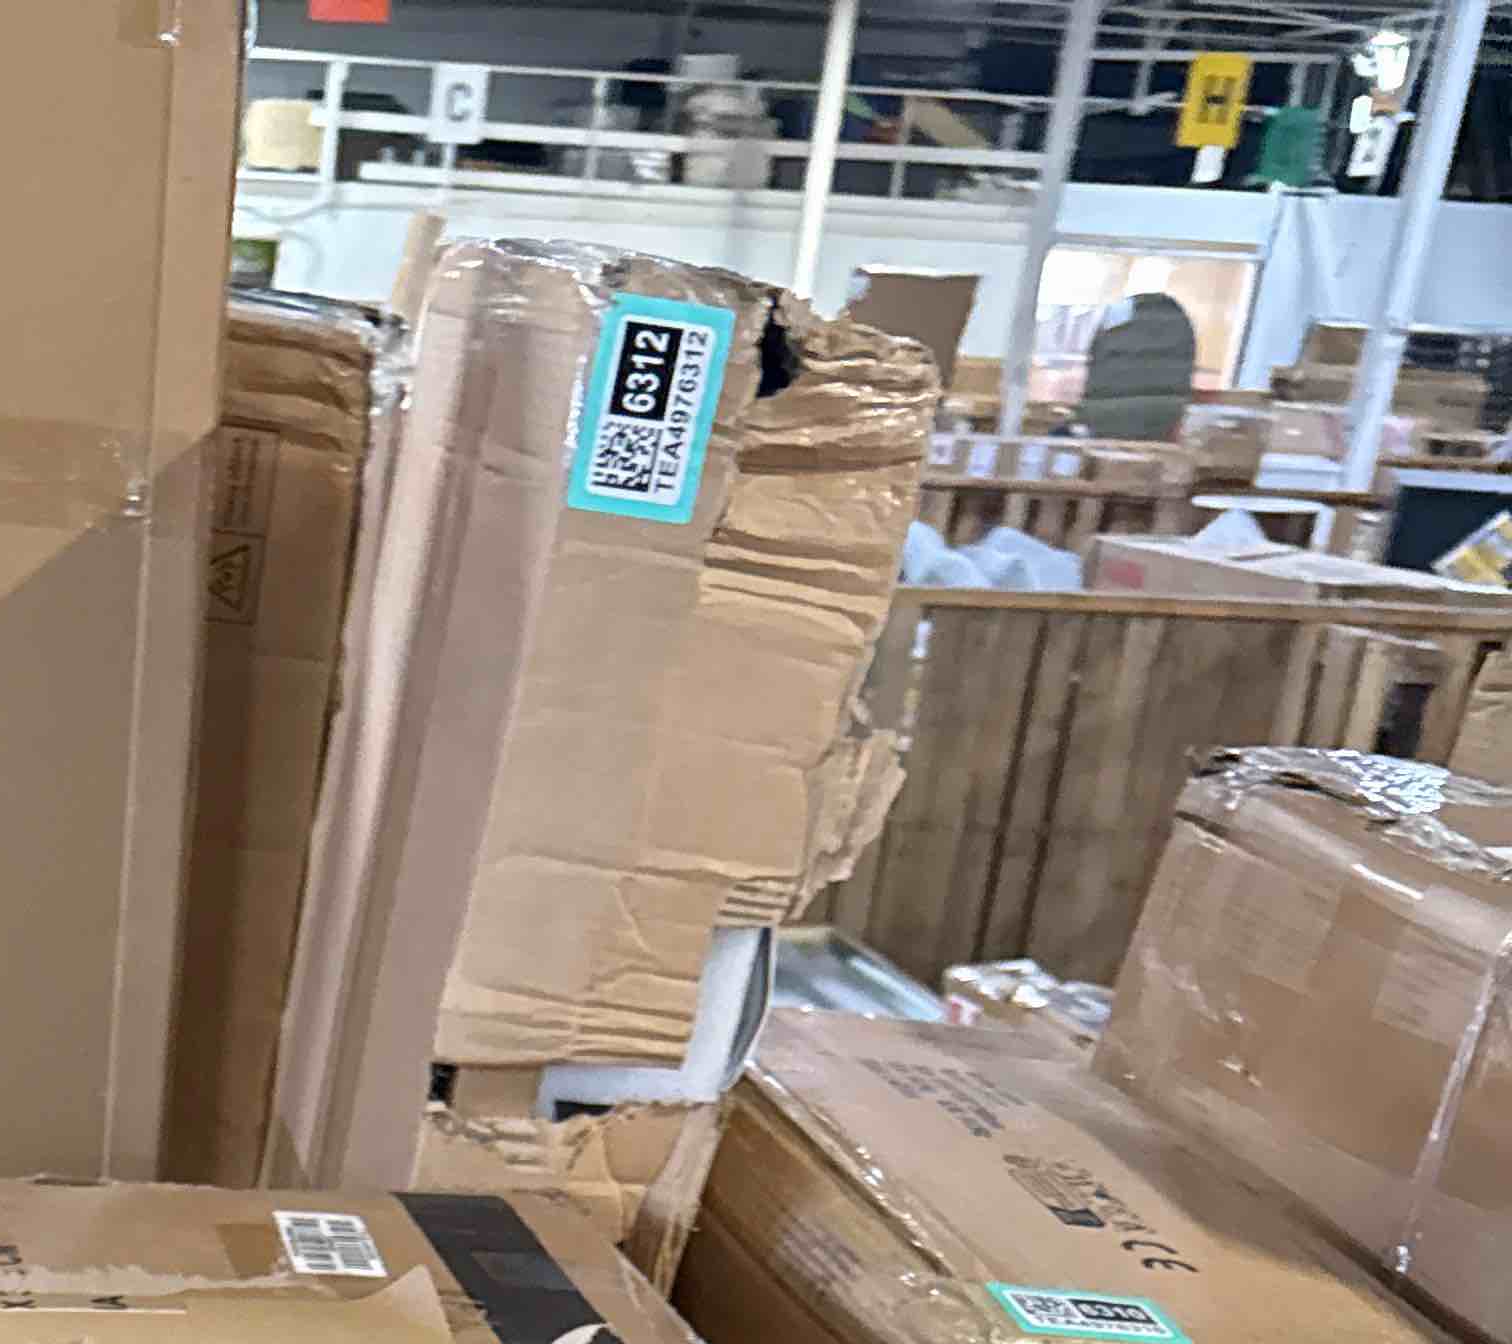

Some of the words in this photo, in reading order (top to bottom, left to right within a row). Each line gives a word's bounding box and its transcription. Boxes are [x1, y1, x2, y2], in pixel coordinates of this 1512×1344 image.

[446, 82, 472, 122] C
[1196, 74, 1238, 124] H
[622, 330, 669, 413] 6312
[654, 330, 708, 493] TEA4976312
